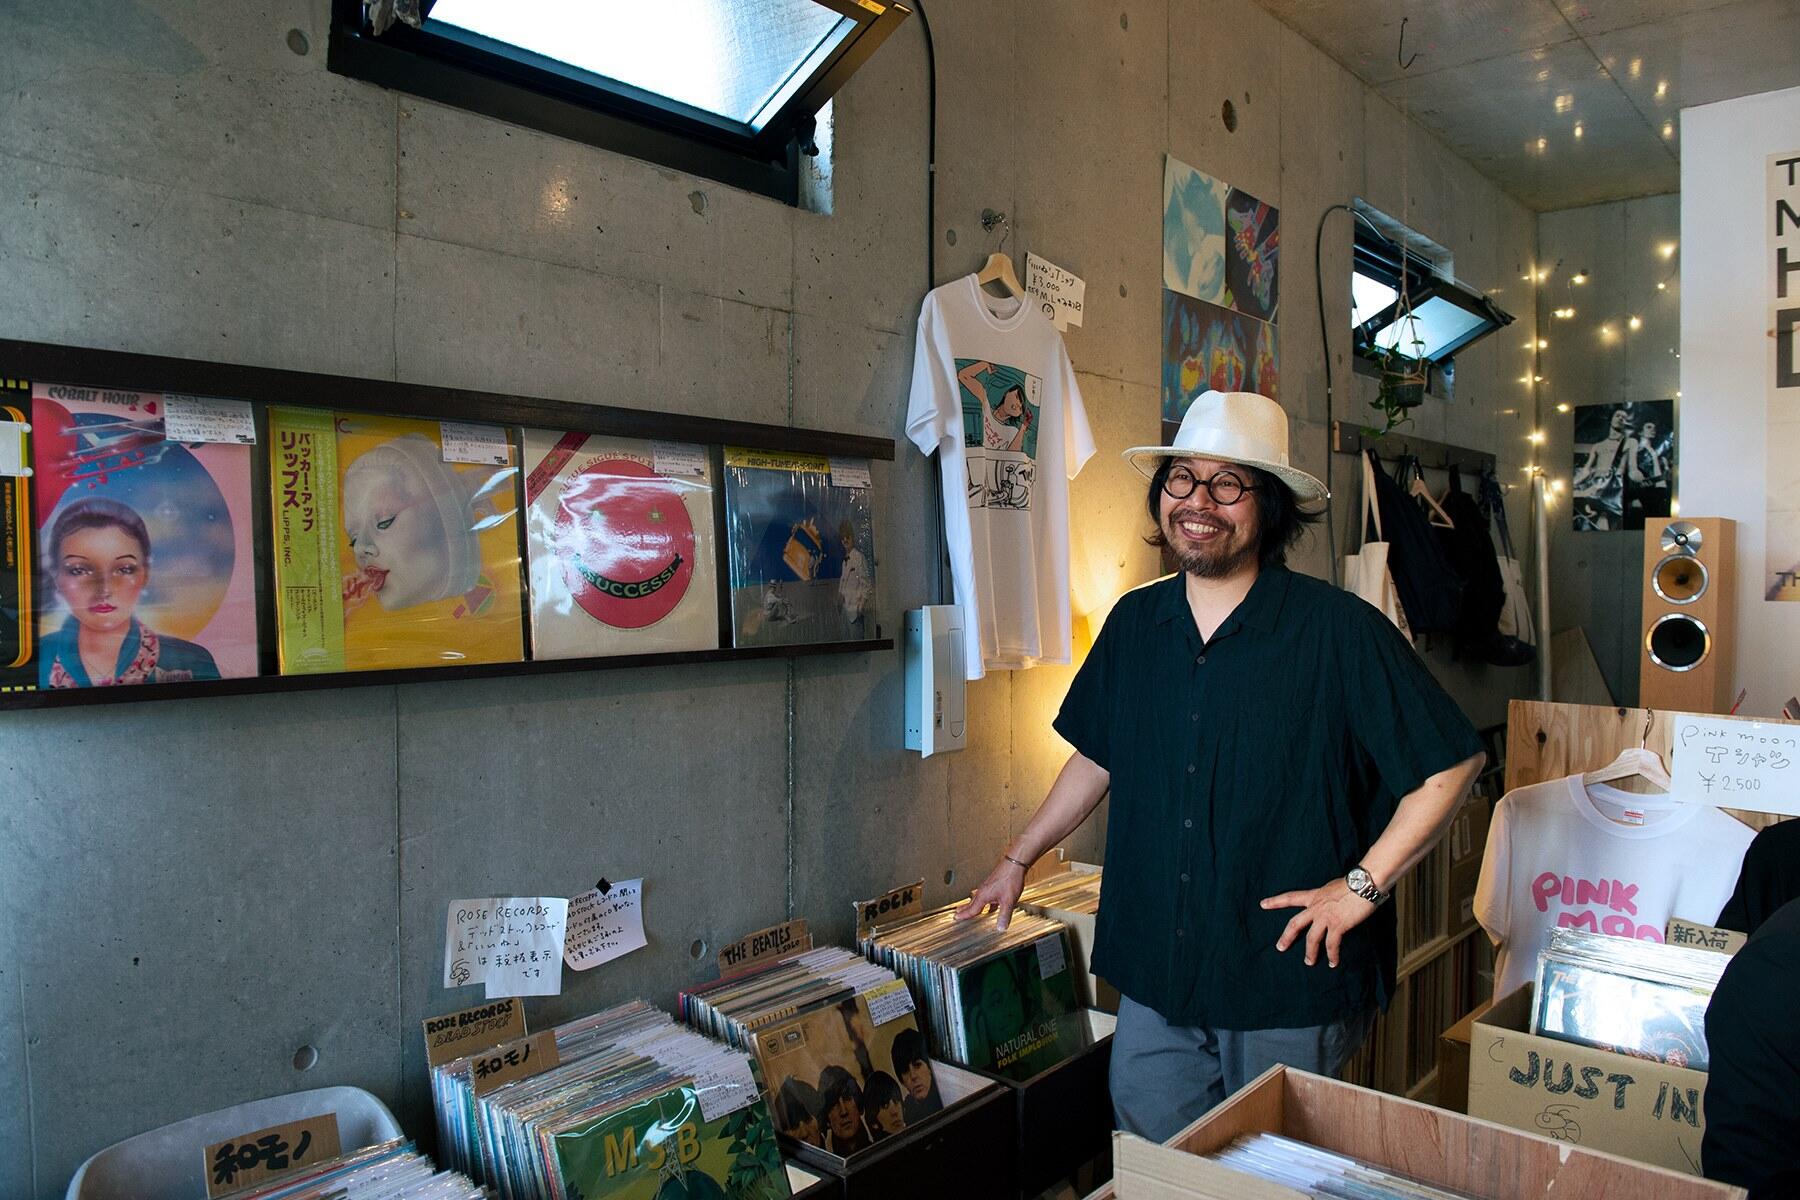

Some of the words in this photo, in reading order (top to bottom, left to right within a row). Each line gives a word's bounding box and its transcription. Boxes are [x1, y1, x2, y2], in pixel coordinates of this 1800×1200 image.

[48, 386, 99, 402] COBALT
[102, 391, 140, 405] HOUR
[281, 430, 300, 508] リップス
[584, 565, 676, 597] SUCCESS!
[865, 889, 913, 922] ROCK
[1532, 872, 1639, 916] PINK
[457, 909, 489, 924] ROSE
[495, 905, 550, 920] RECORDS
[724, 942, 747, 966] THE
[752, 926, 791, 957] BEATLES
[1673, 923, 1729, 950] 新入荷
[522, 967, 541, 978] です
[426, 1015, 458, 1035] ROSE
[458, 999, 513, 1027] RECORDS
[433, 1027, 472, 1048] DEAD
[471, 1012, 513, 1037] STOCK
[995, 1029, 1038, 1060] NATURAL
[1038, 1018, 1057, 1037] ONE
[475, 1043, 530, 1080] 和モノ
[997, 1052, 1018, 1069] FOLK
[1509, 1051, 1636, 1110] JUST
[1653, 1081, 1701, 1128] IN
[213, 1130, 312, 1185] 和モノ
